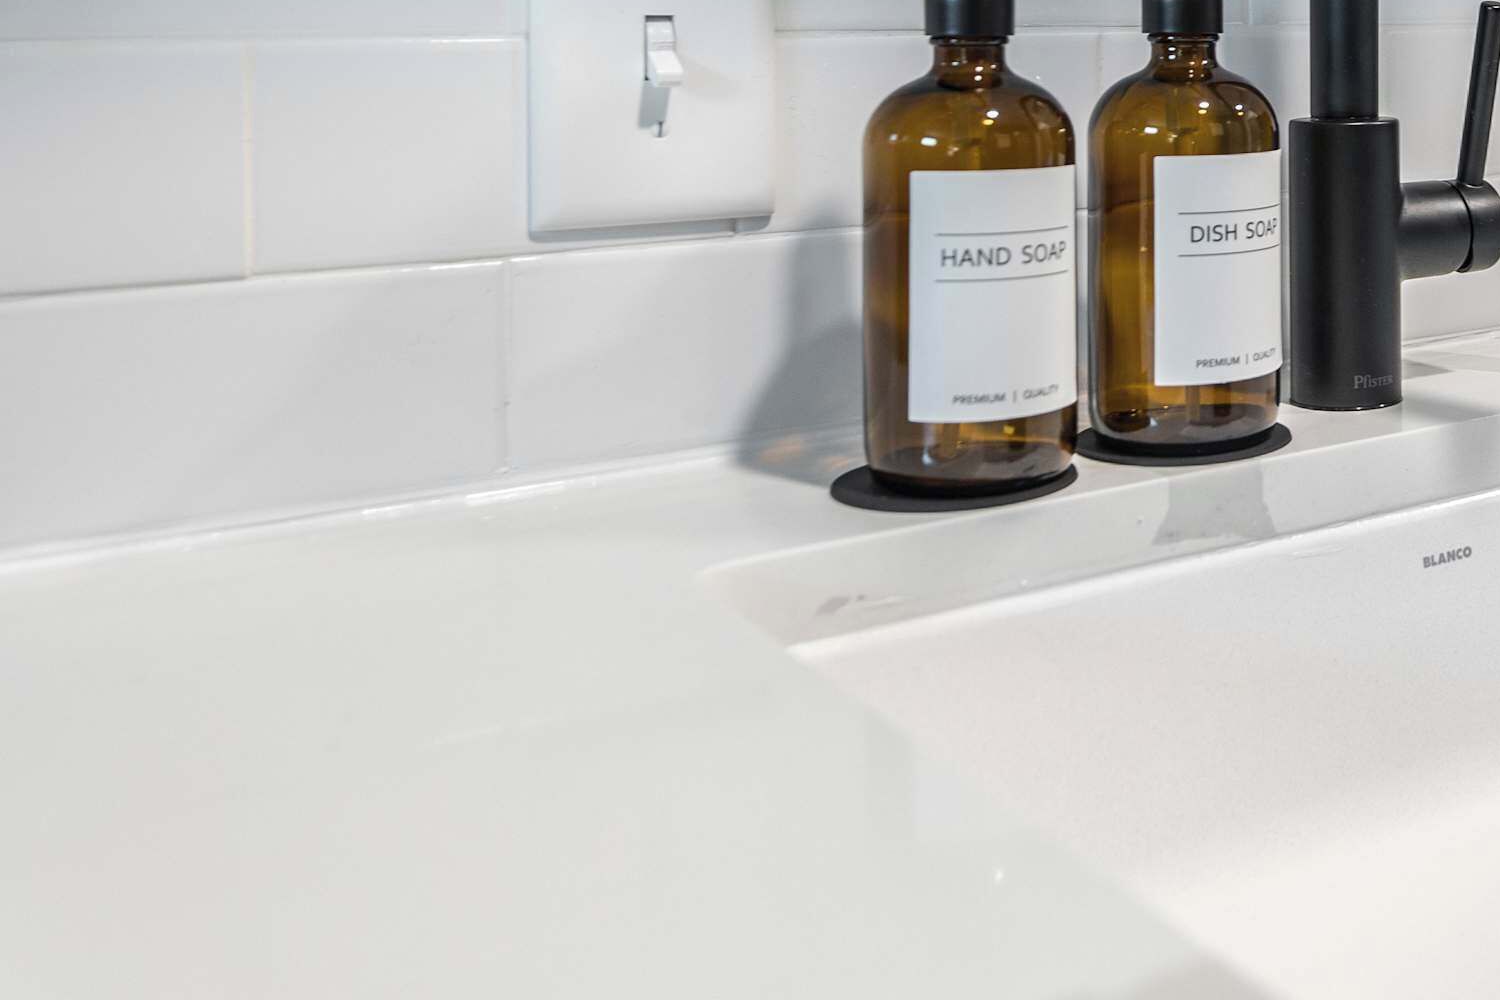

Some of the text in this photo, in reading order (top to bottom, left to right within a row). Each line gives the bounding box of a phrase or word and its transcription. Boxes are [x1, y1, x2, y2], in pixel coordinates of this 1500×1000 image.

[1190, 217, 1277, 243] DISH SOAP
[940, 240, 1066, 267] HAND SOAP
[1196, 355, 1240, 368] PREMIUM
[952, 392, 1006, 404] PREMIUM
[1023, 383, 1059, 400] QUALITY
[1423, 546, 1472, 569] BLANCO
